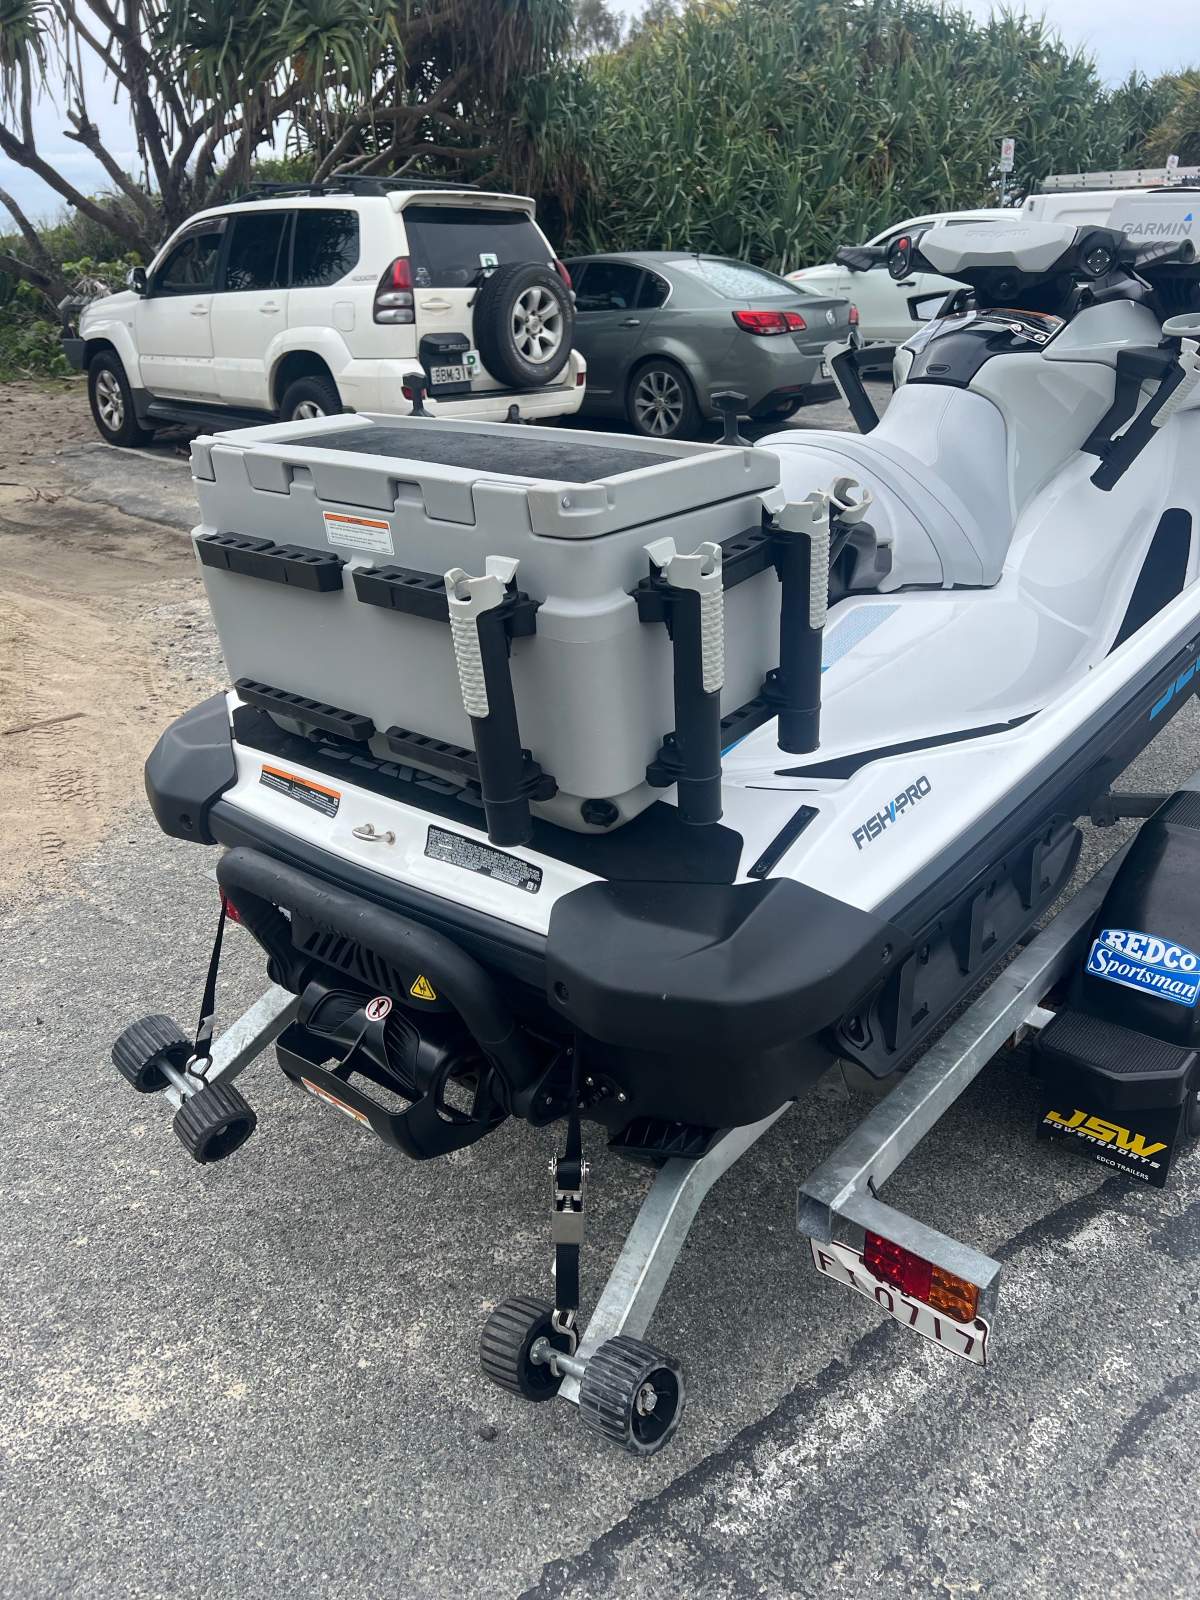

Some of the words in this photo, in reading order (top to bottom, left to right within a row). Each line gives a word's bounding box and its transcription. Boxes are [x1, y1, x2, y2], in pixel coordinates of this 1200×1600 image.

[1121, 222, 1193, 236] GARMIN
[1090, 948, 1196, 998] Sportsman
[1105, 931, 1197, 971] REDCO
[1042, 1118, 1161, 1169] POWERSPORTS
[1045, 1109, 1168, 1157] JSW
[1096, 1154, 1116, 1167] EDCO
[1116, 1162, 1150, 1181] TRAILERS
